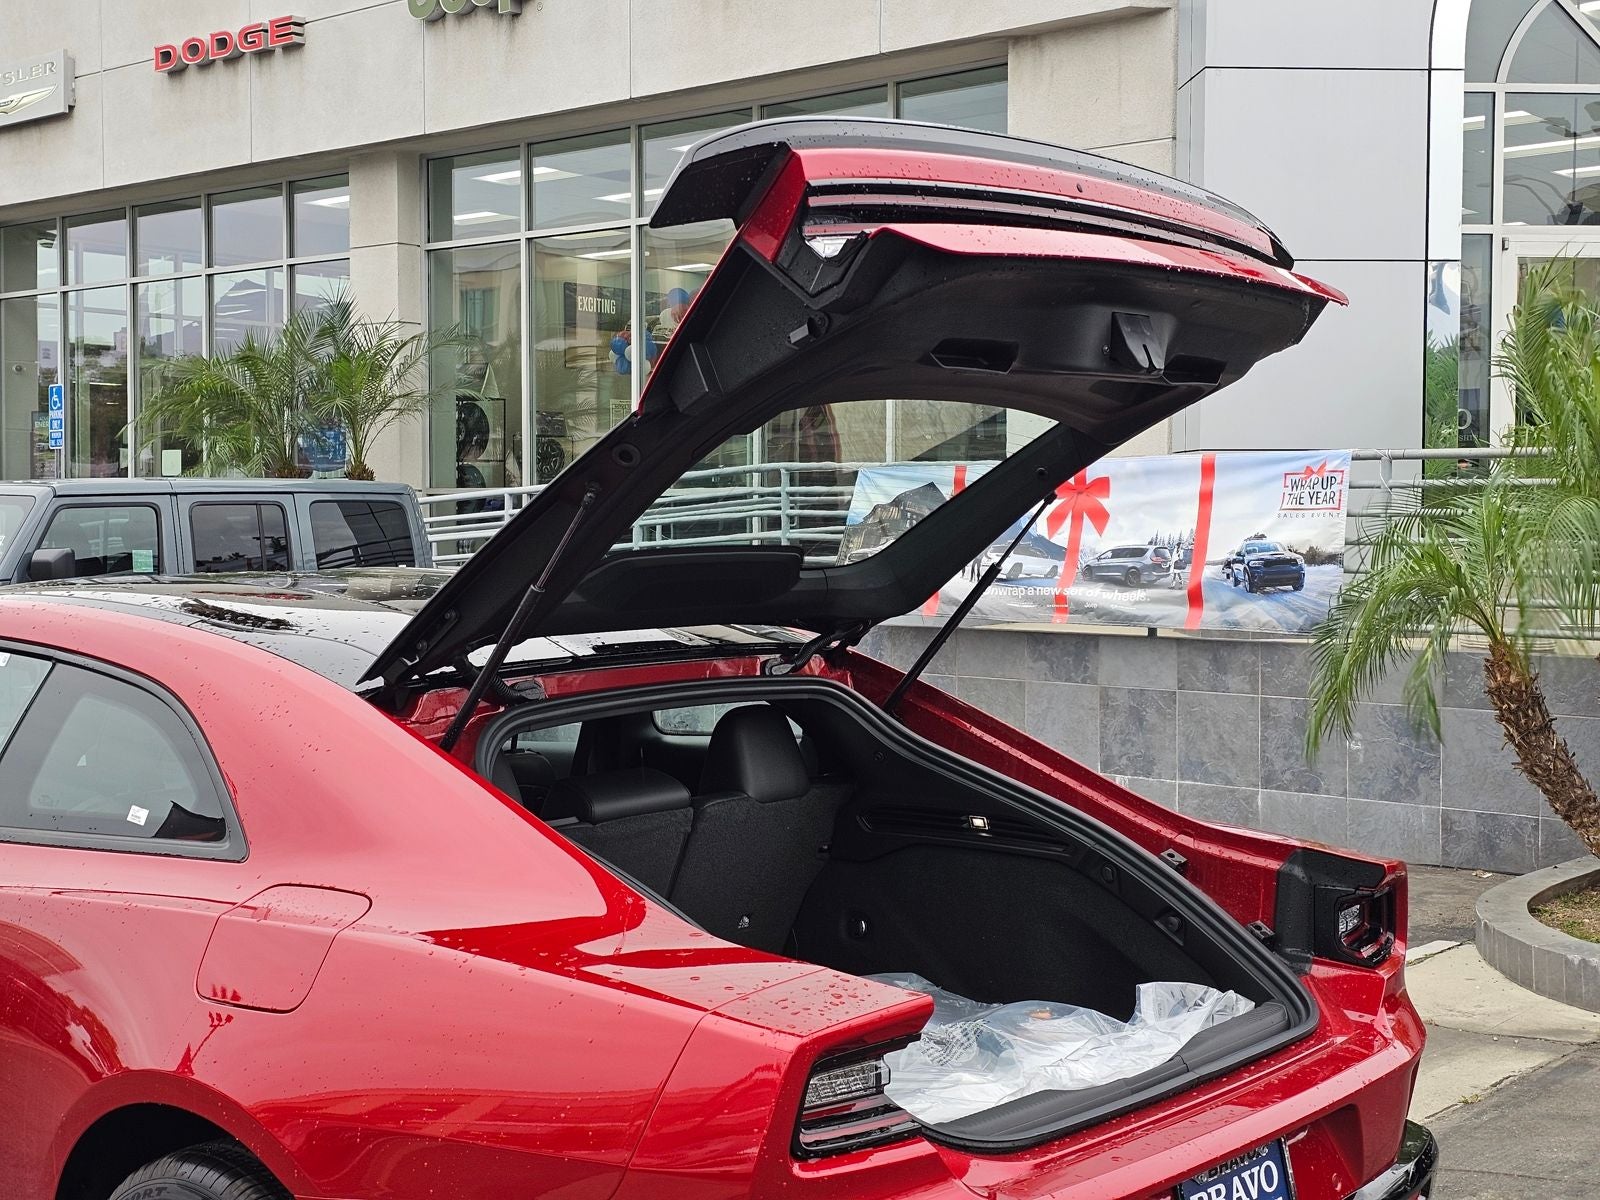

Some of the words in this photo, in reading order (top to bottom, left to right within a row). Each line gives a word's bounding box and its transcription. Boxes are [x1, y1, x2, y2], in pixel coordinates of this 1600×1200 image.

[153, 15, 294, 72] DODGE
[0, 61, 56, 86] SLER
[578, 296, 616, 314] EXCITING
[1290, 477, 1319, 491] WRAP
[1321, 476, 1337, 490] UP
[1287, 492, 1304, 505] THE
[1308, 490, 1336, 505] YEAR
[1027, 587, 1036, 596] a
[1036, 586, 1060, 596] new
[1063, 585, 1085, 596] set
[1086, 583, 1105, 598] of
